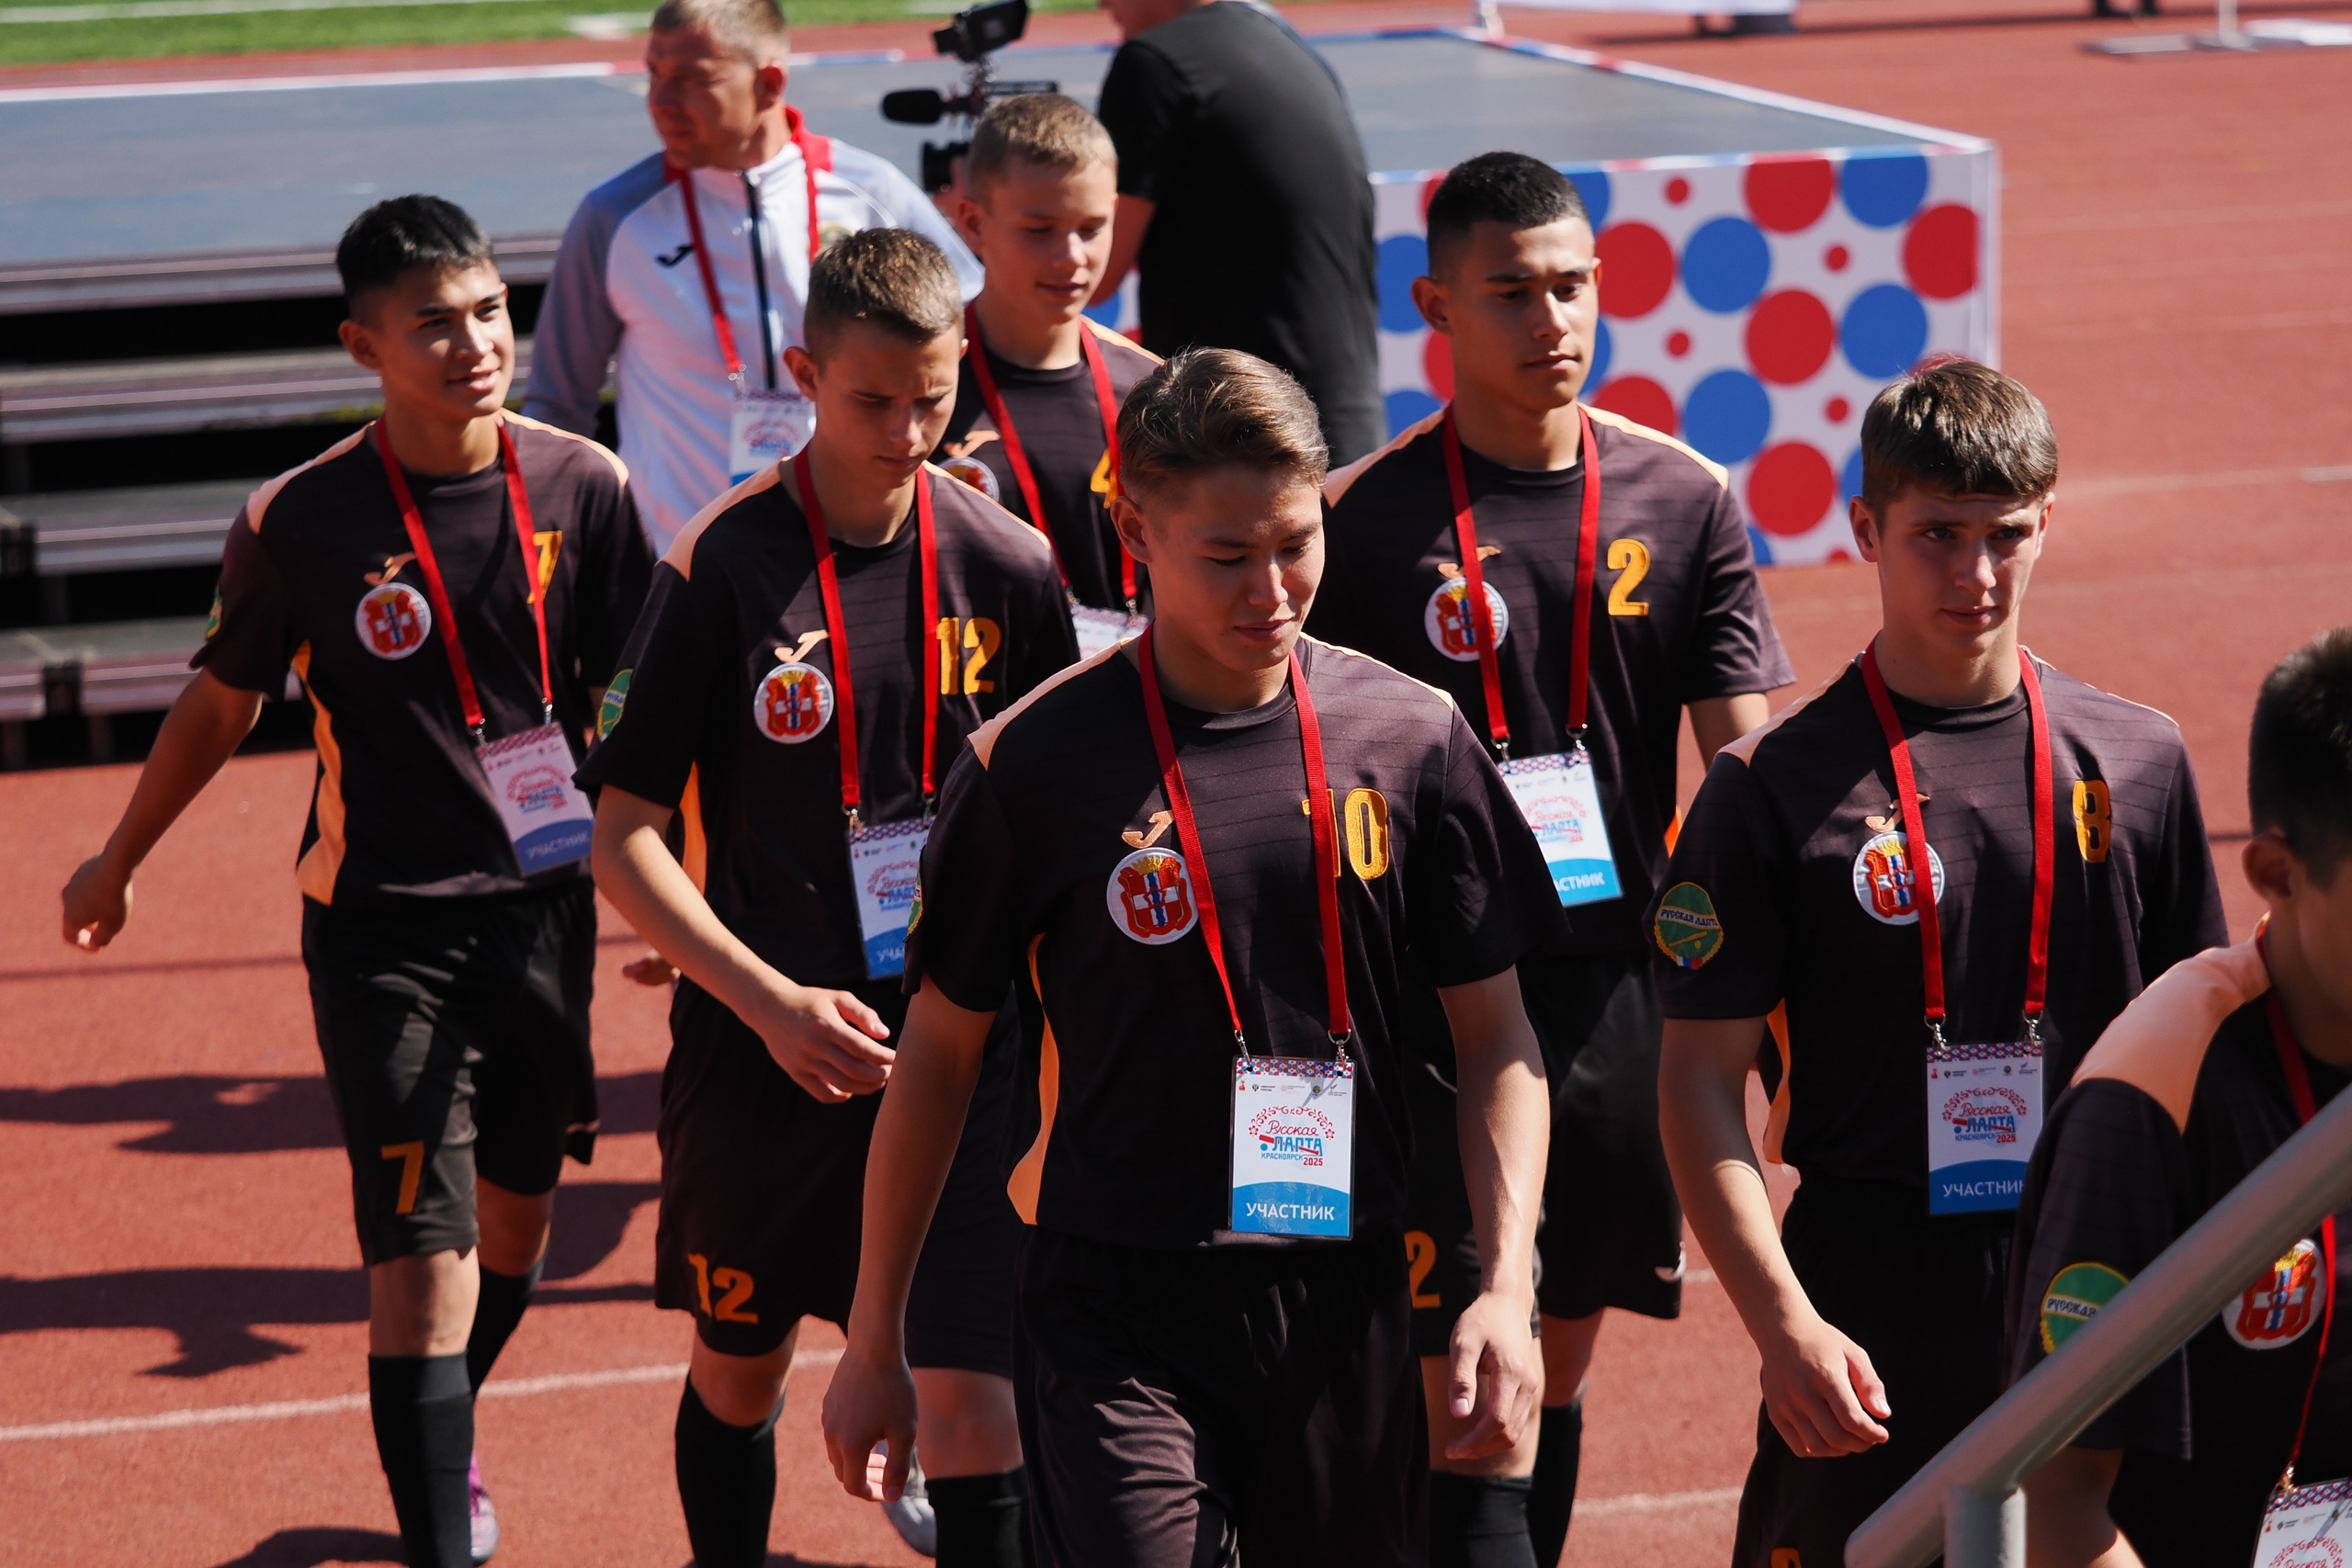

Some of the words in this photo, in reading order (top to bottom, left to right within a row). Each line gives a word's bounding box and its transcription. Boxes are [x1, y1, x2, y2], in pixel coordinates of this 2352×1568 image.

[1091, 449, 1116, 509] 4
[526, 530, 562, 604] 7
[1607, 538, 1651, 615] 2
[936, 617, 1001, 695] 12
[2073, 780, 2111, 863] 8
[1553, 872, 1605, 891] СТНИК
[1959, 1102, 2011, 1117] Русская
[1266, 1120, 1319, 1136] Русская
[1965, 1116, 2016, 1134] ЛАПТА
[1272, 1136, 1323, 1156] ЛАПТА
[1996, 1134, 2017, 1144] 2025
[1261, 1152, 1304, 1161] КРАСНОЯРСК
[1303, 1156, 1323, 1167] 2025
[380, 1141, 424, 1215] 7
[1246, 1202, 1335, 1221] УЧАСТНИК
[1404, 1230, 1442, 1309] 2
[687, 1252, 759, 1325] 12
